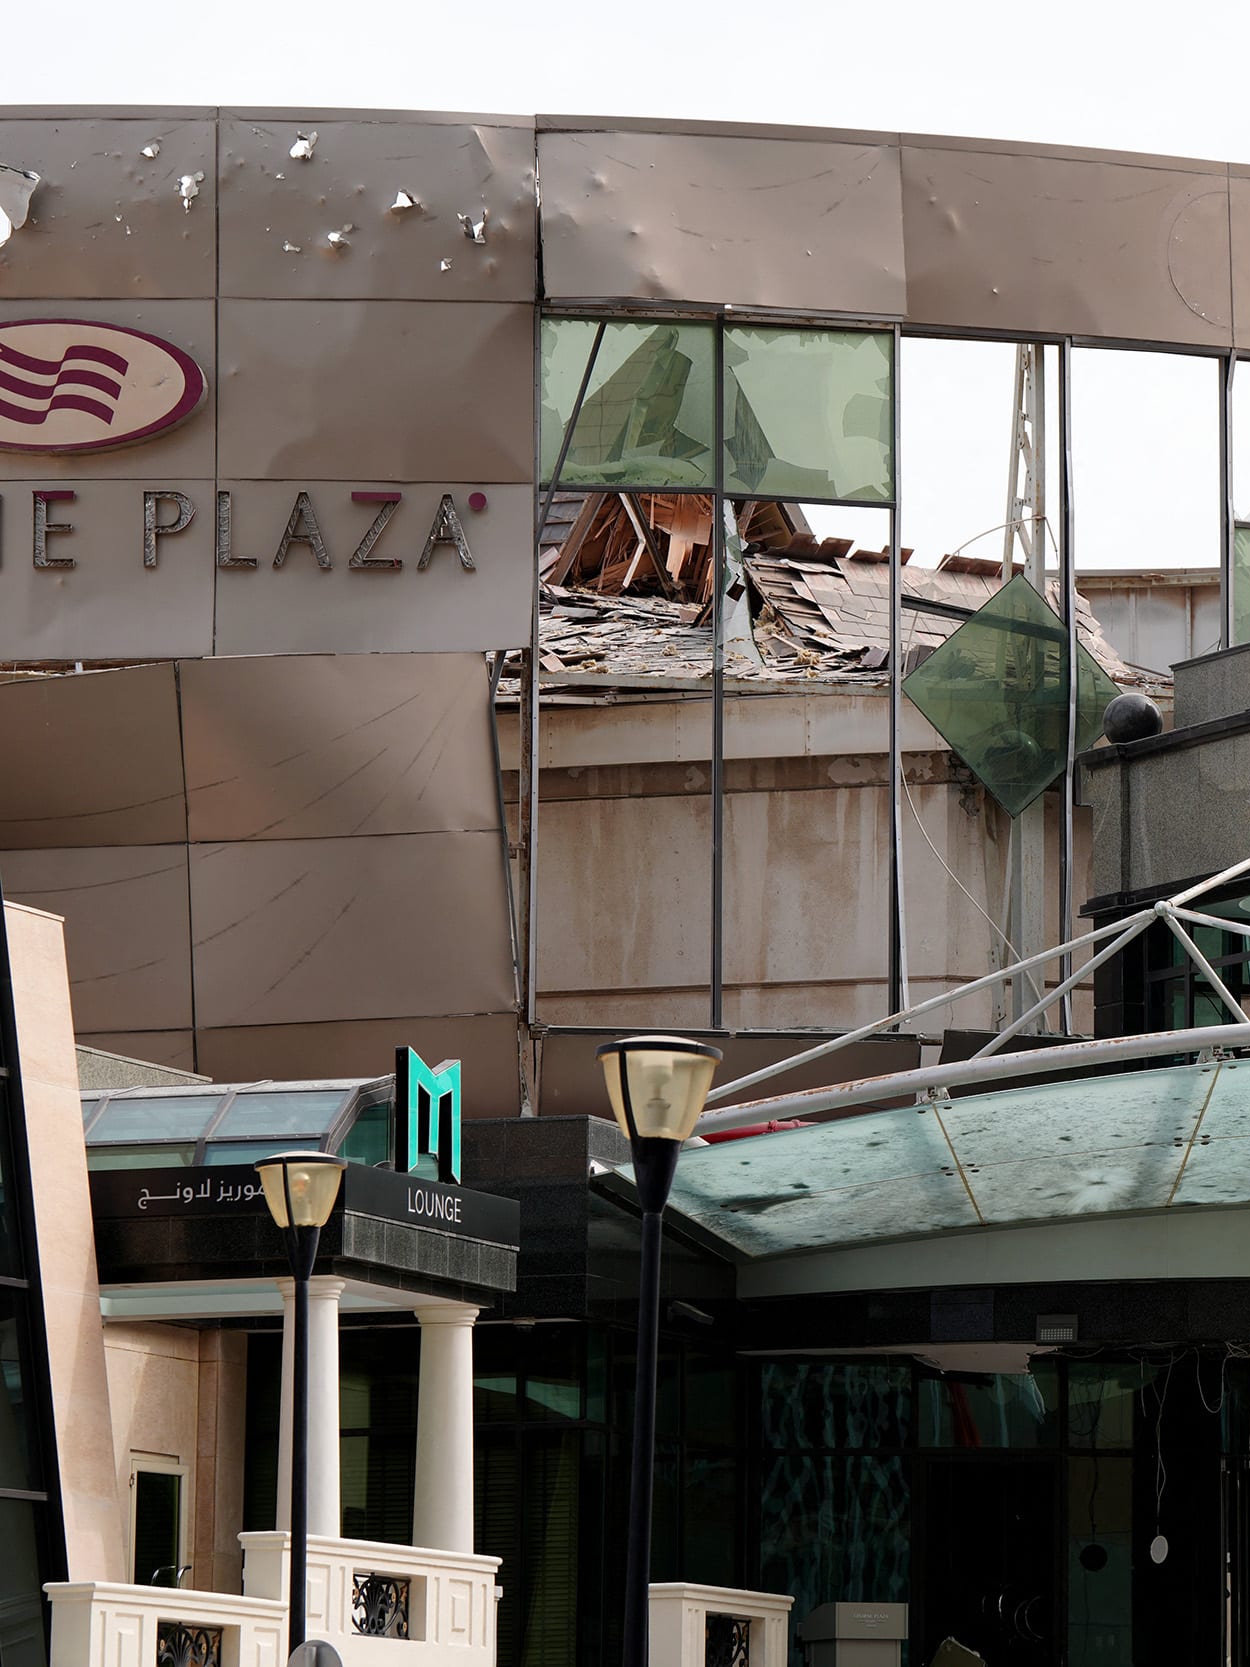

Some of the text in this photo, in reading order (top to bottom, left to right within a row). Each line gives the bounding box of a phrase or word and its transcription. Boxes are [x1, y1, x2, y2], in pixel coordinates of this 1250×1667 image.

[0, 490, 476, 570] E PLAZA
[396, 1046, 461, 1186] M
[408, 1187, 462, 1223] LOUNGE
